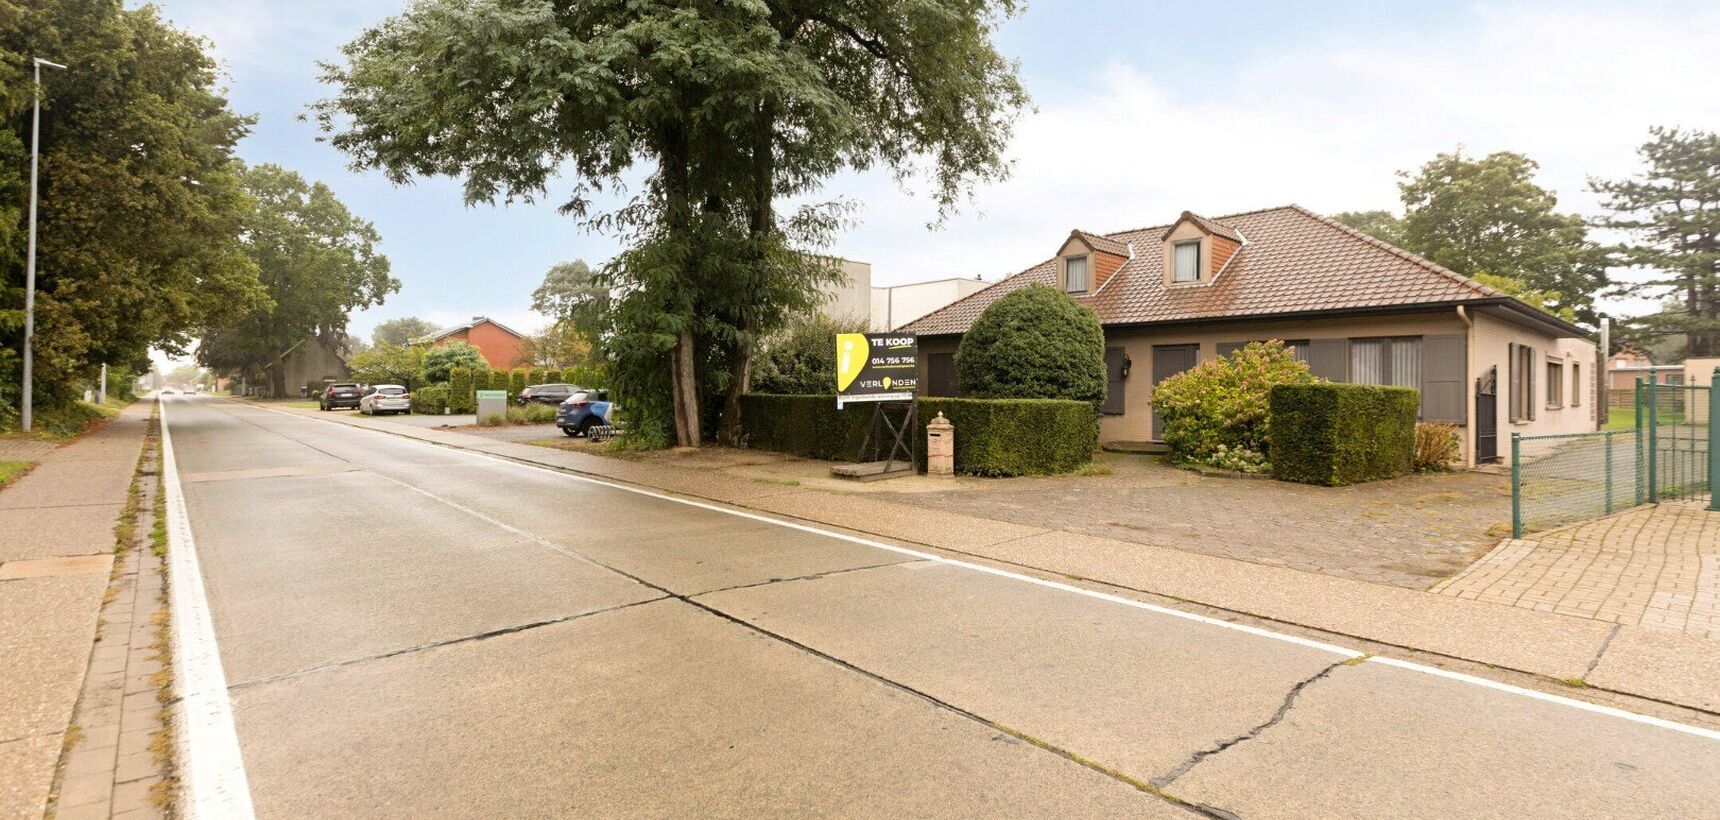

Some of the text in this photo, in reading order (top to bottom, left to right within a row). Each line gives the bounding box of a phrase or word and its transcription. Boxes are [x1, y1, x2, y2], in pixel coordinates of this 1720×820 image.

[871, 338, 914, 347] TE KOOP
[872, 357, 885, 365] 014
[901, 356, 915, 364] 756
[860, 377, 917, 389] VERLNDEN
